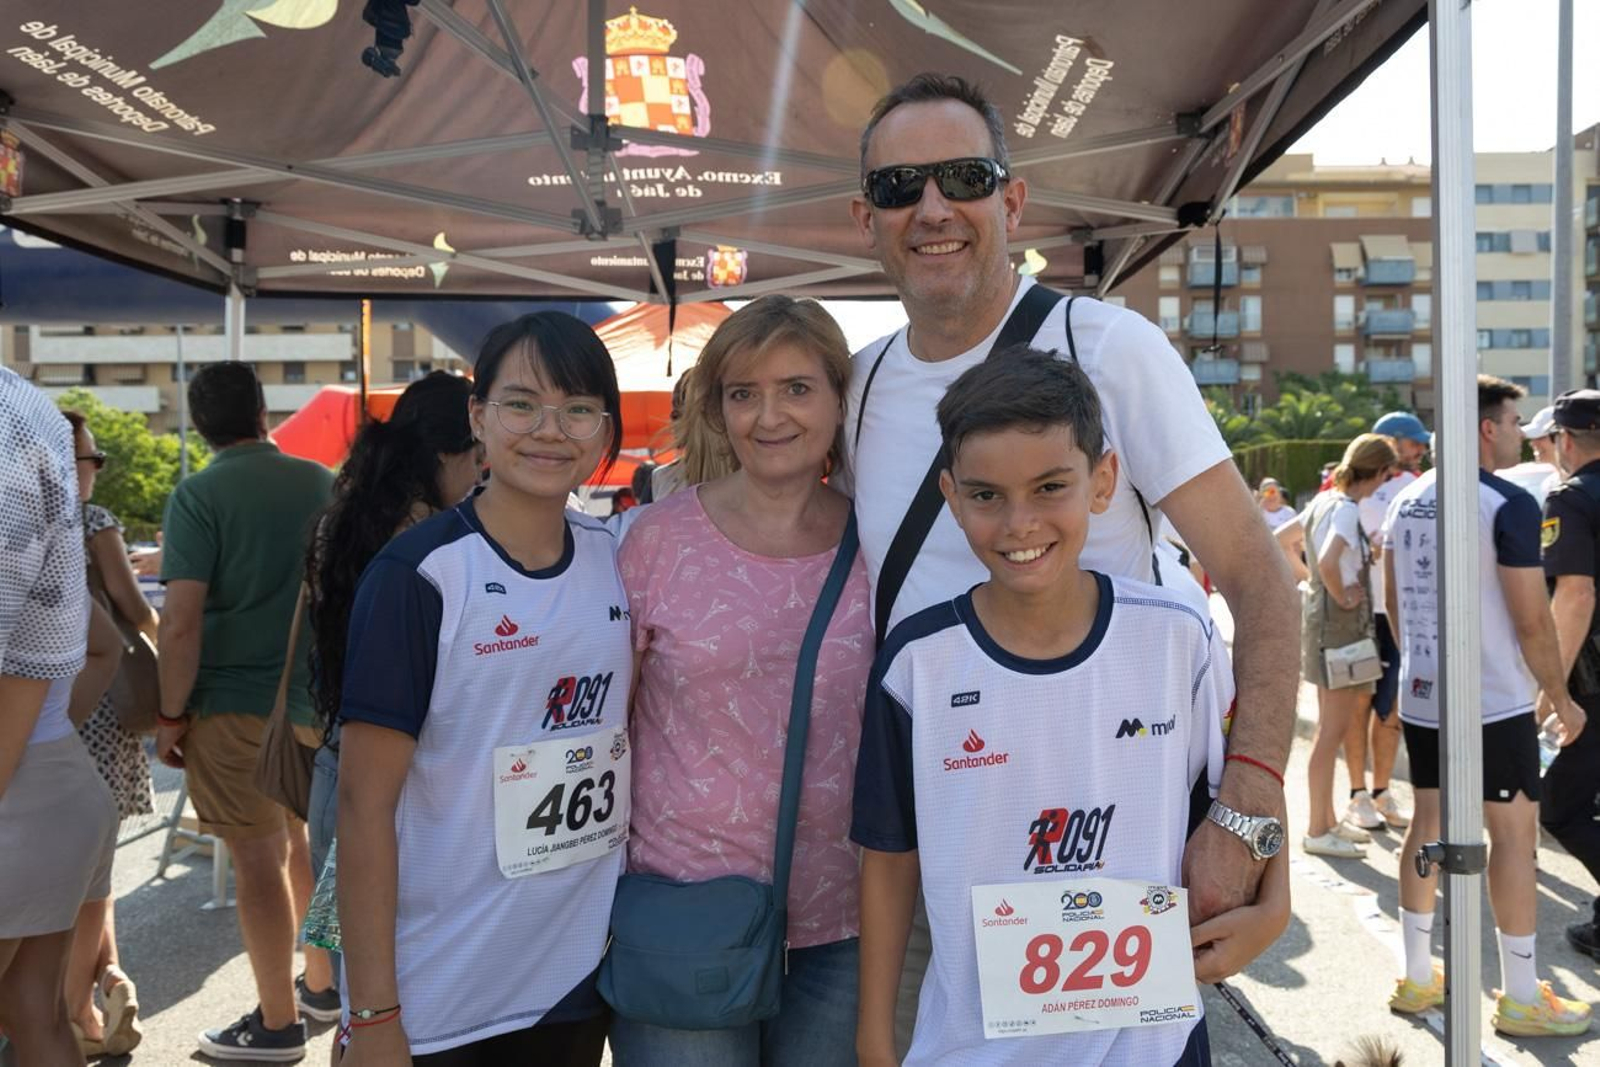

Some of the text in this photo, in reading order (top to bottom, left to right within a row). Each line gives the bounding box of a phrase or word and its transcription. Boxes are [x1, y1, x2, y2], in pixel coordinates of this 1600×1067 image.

[474, 635, 540, 656] Santander
[943, 752, 1009, 771] Santander
[499, 771, 538, 784] Santander
[525, 769, 616, 837] 463
[527, 843, 549, 856] LUCÍA
[982, 917, 1028, 928] Santander
[1019, 924, 1153, 995] 829
[1097, 996, 1140, 1008] DOMINGO
[1140, 1012, 1196, 1023] NACIONAL
